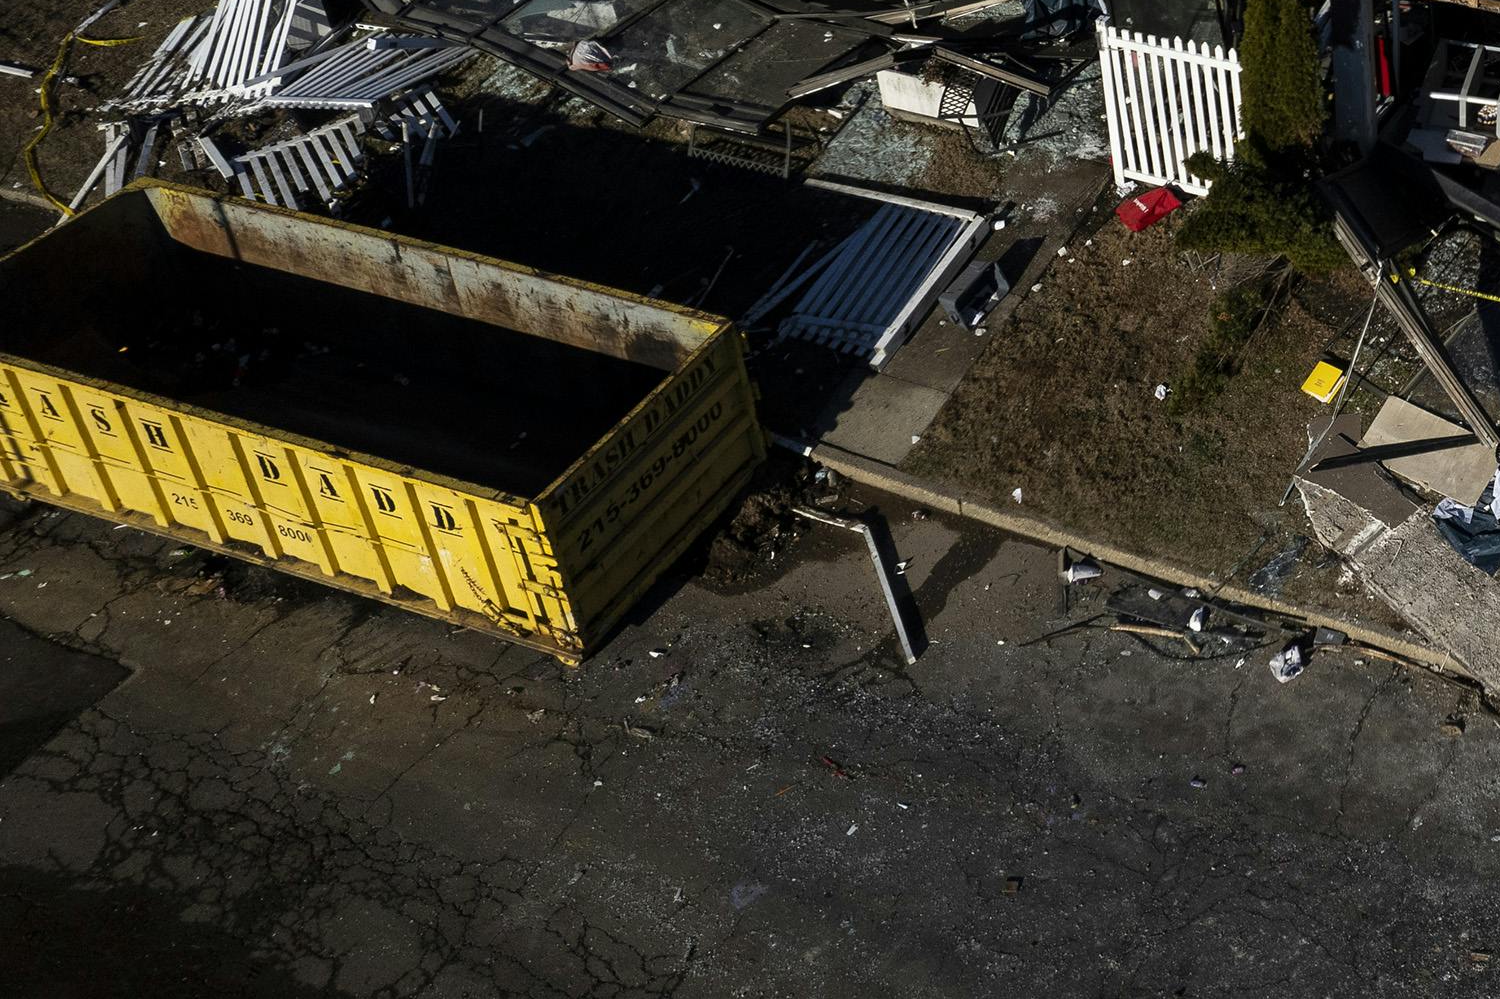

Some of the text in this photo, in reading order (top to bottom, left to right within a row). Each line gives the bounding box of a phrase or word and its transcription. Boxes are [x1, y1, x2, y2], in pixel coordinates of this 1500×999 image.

[172, 492, 199, 510] 215
[226, 509, 254, 526] 369
[553, 356, 717, 515] TRASH DADDY
[577, 401, 723, 552] 215-369-8000
